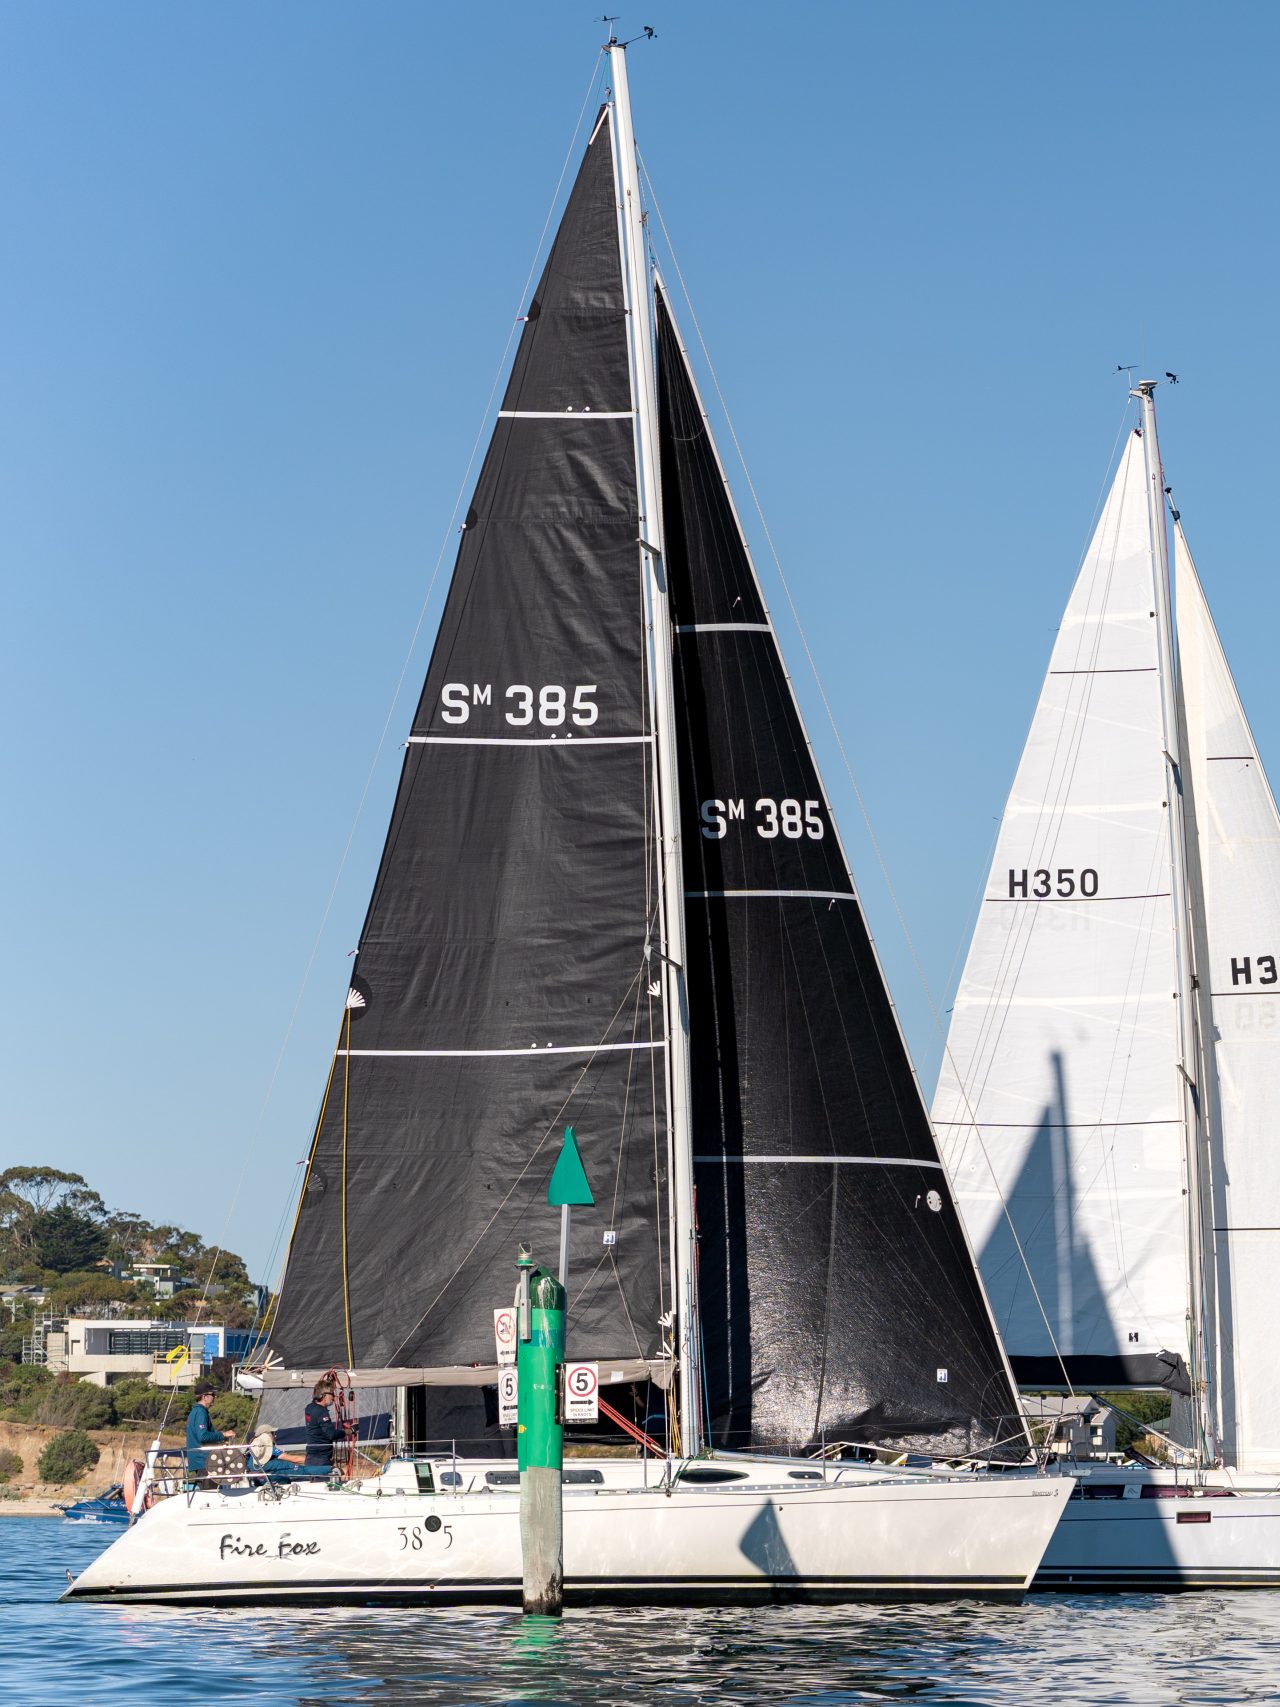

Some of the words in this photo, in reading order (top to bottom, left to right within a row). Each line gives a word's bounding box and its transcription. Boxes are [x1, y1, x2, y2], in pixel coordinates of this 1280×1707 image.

[505, 684, 599, 726] 385
[755, 798, 824, 839] 385
[1008, 868, 1099, 898] H350
[505, 1377, 514, 1396] 5
[575, 1372, 589, 1391] 5
[219, 1533, 268, 1560] Fire
[277, 1532, 321, 1559] Fox
